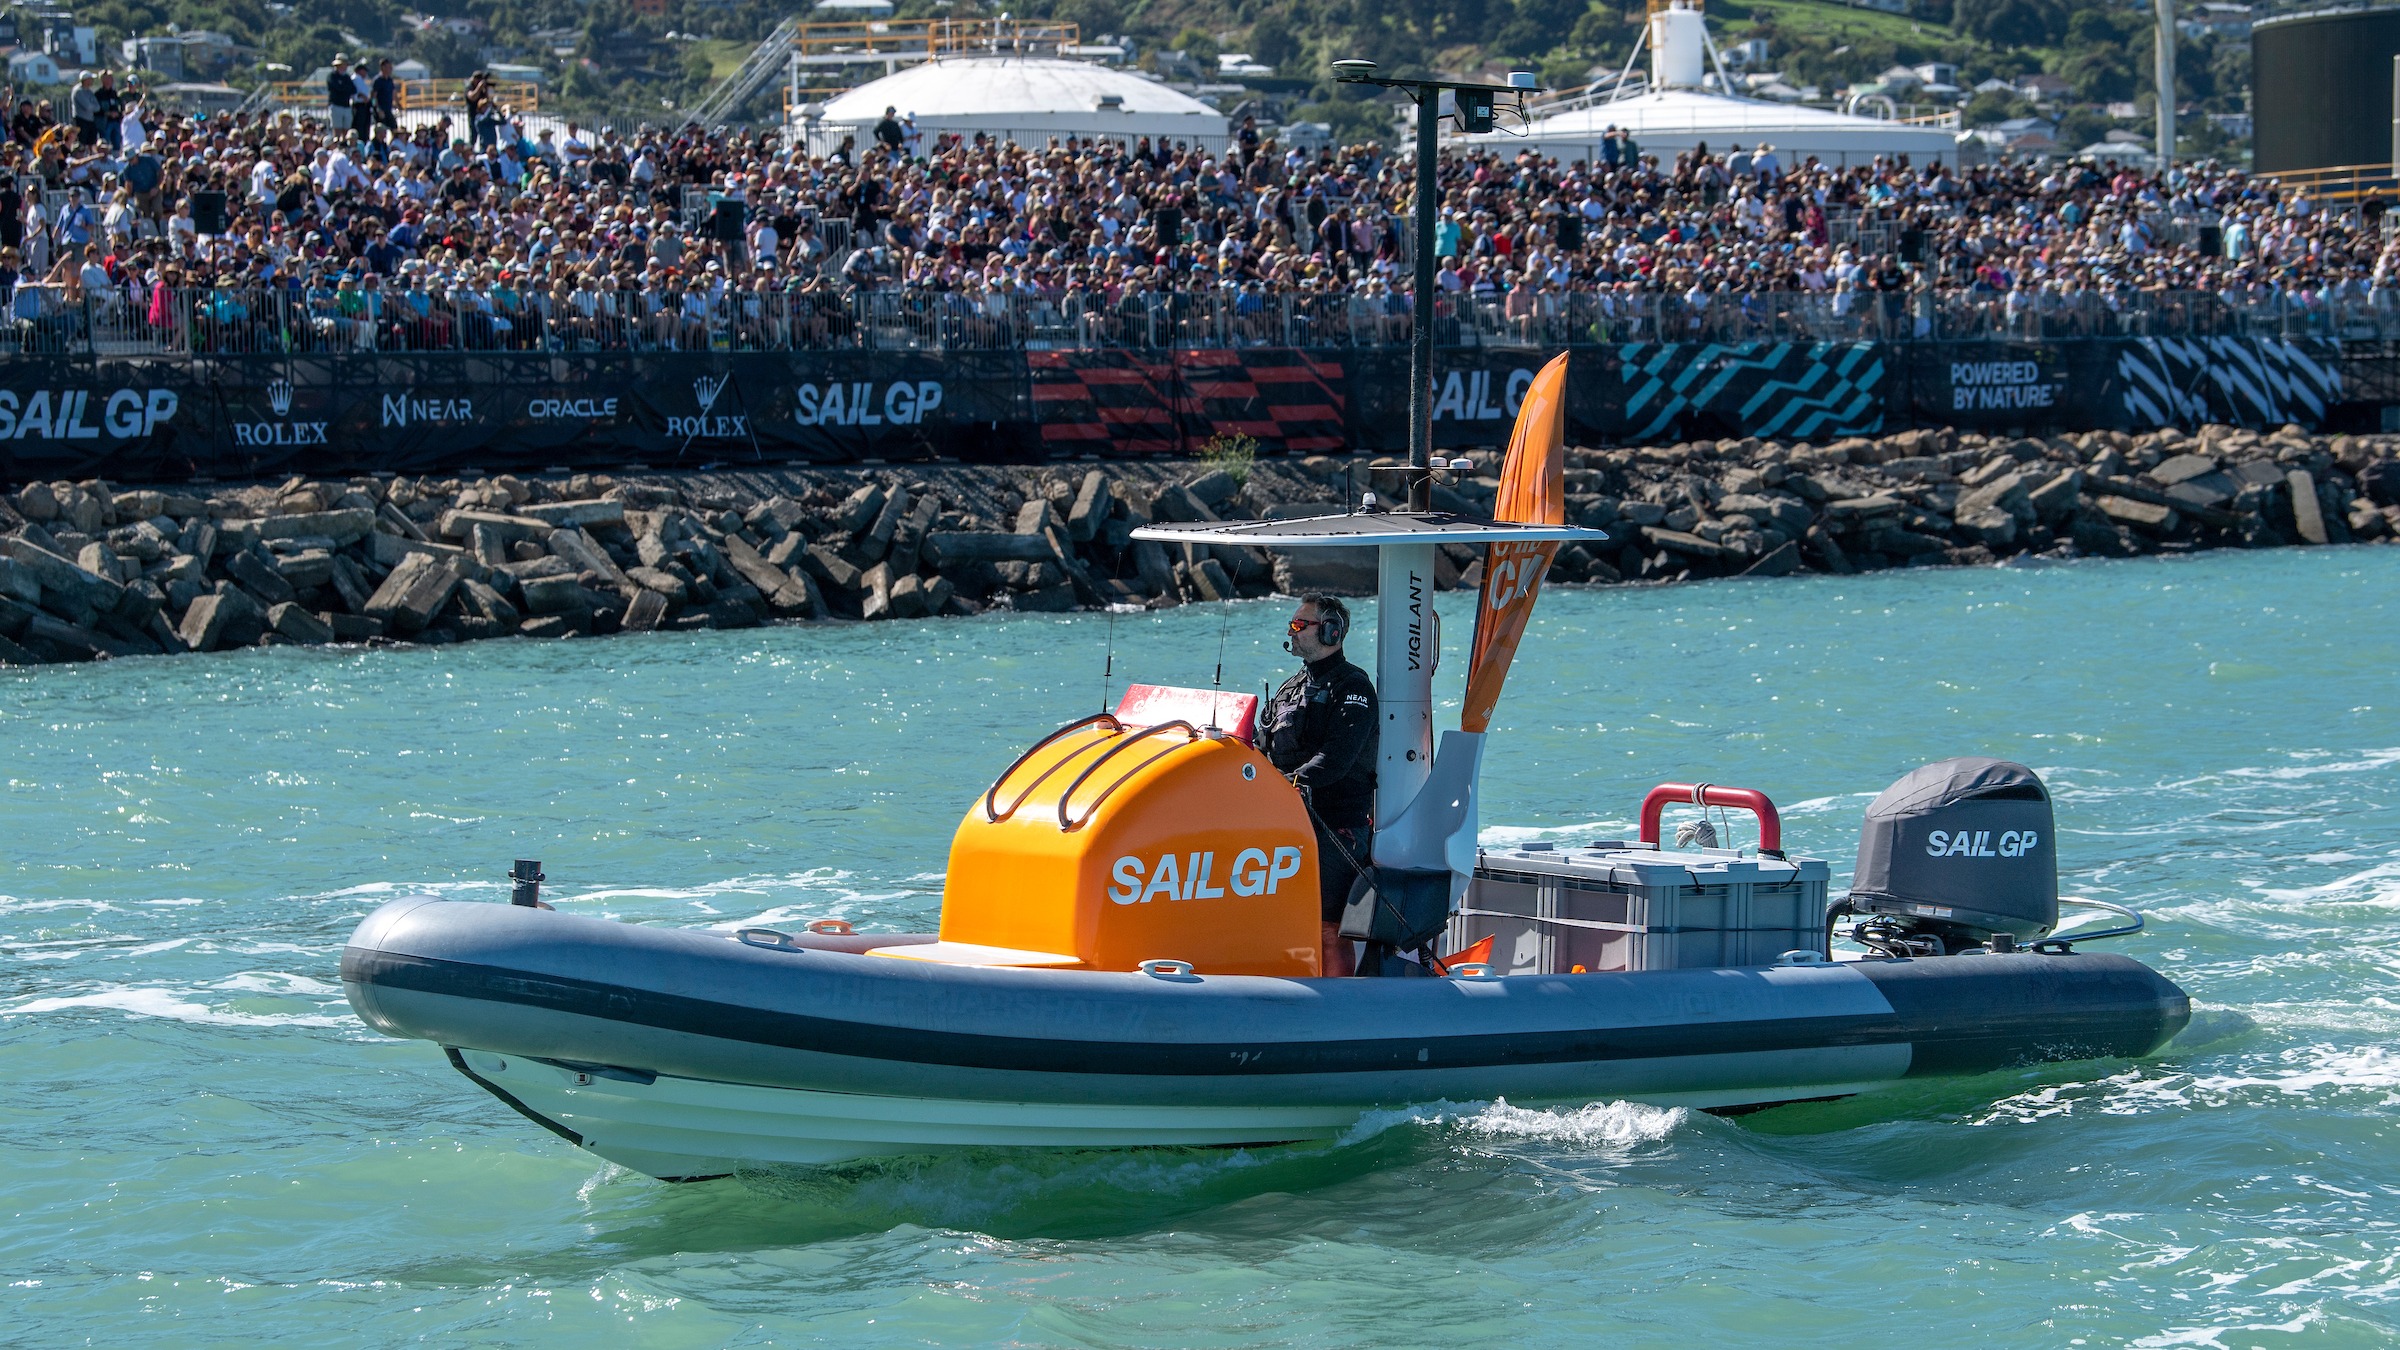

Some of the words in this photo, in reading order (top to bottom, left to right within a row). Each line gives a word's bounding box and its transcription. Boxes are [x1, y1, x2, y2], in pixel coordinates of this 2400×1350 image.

[1951, 361, 2039, 385] POWERED
[413, 399, 473, 420] NEAR
[529, 398, 618, 418] ORACLE
[1953, 386, 1978, 410] BY
[234, 422, 328, 446] ROLEX
[665, 415, 748, 437] ROLEX
[1408, 570, 1422, 671] VIGILANT
[1346, 694, 1368, 704] NEAR
